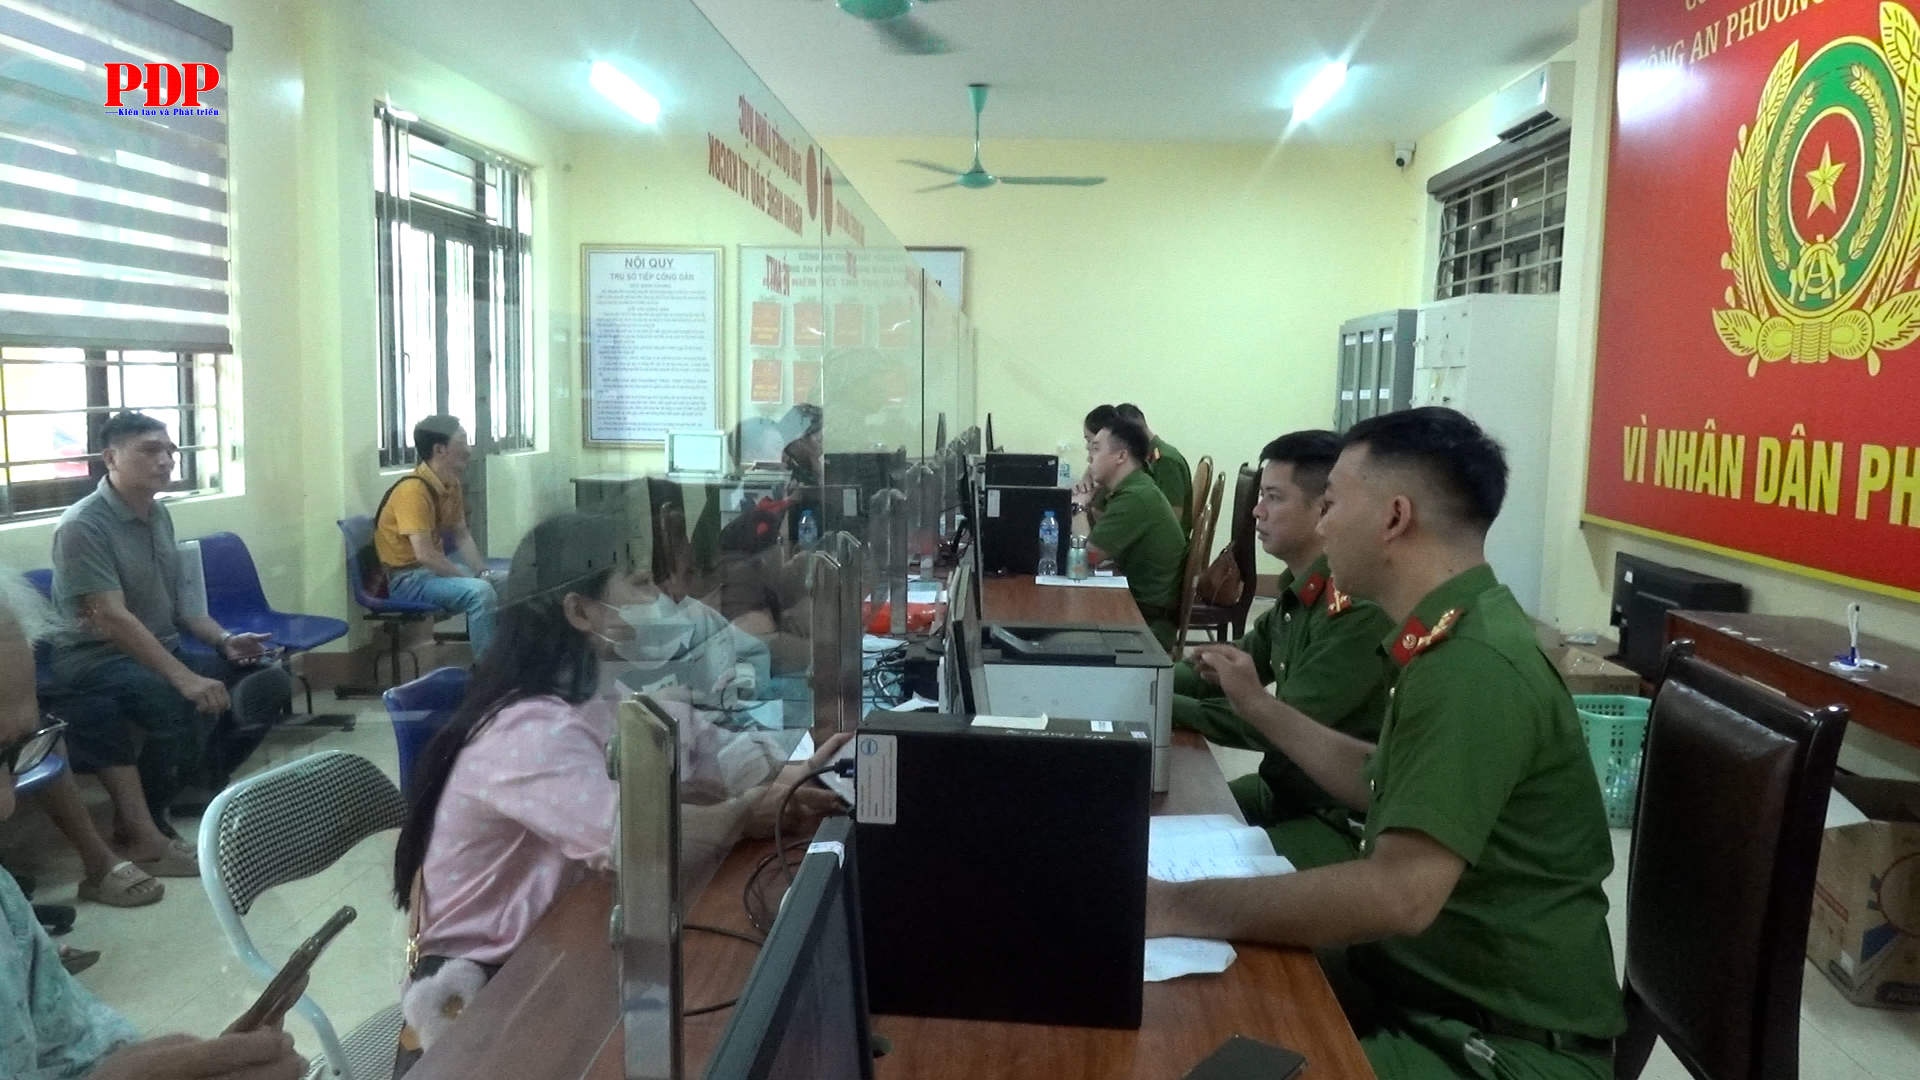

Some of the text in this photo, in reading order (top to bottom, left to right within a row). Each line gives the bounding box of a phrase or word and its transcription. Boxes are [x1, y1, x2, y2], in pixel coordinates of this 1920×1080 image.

[1689, 21, 1720, 64] AN
[625, 255, 674, 269] NỘI QUY
[1623, 414, 1648, 483] VÌ
[1654, 418, 1745, 500] NHÂN
[1754, 423, 1843, 515] DÂN
